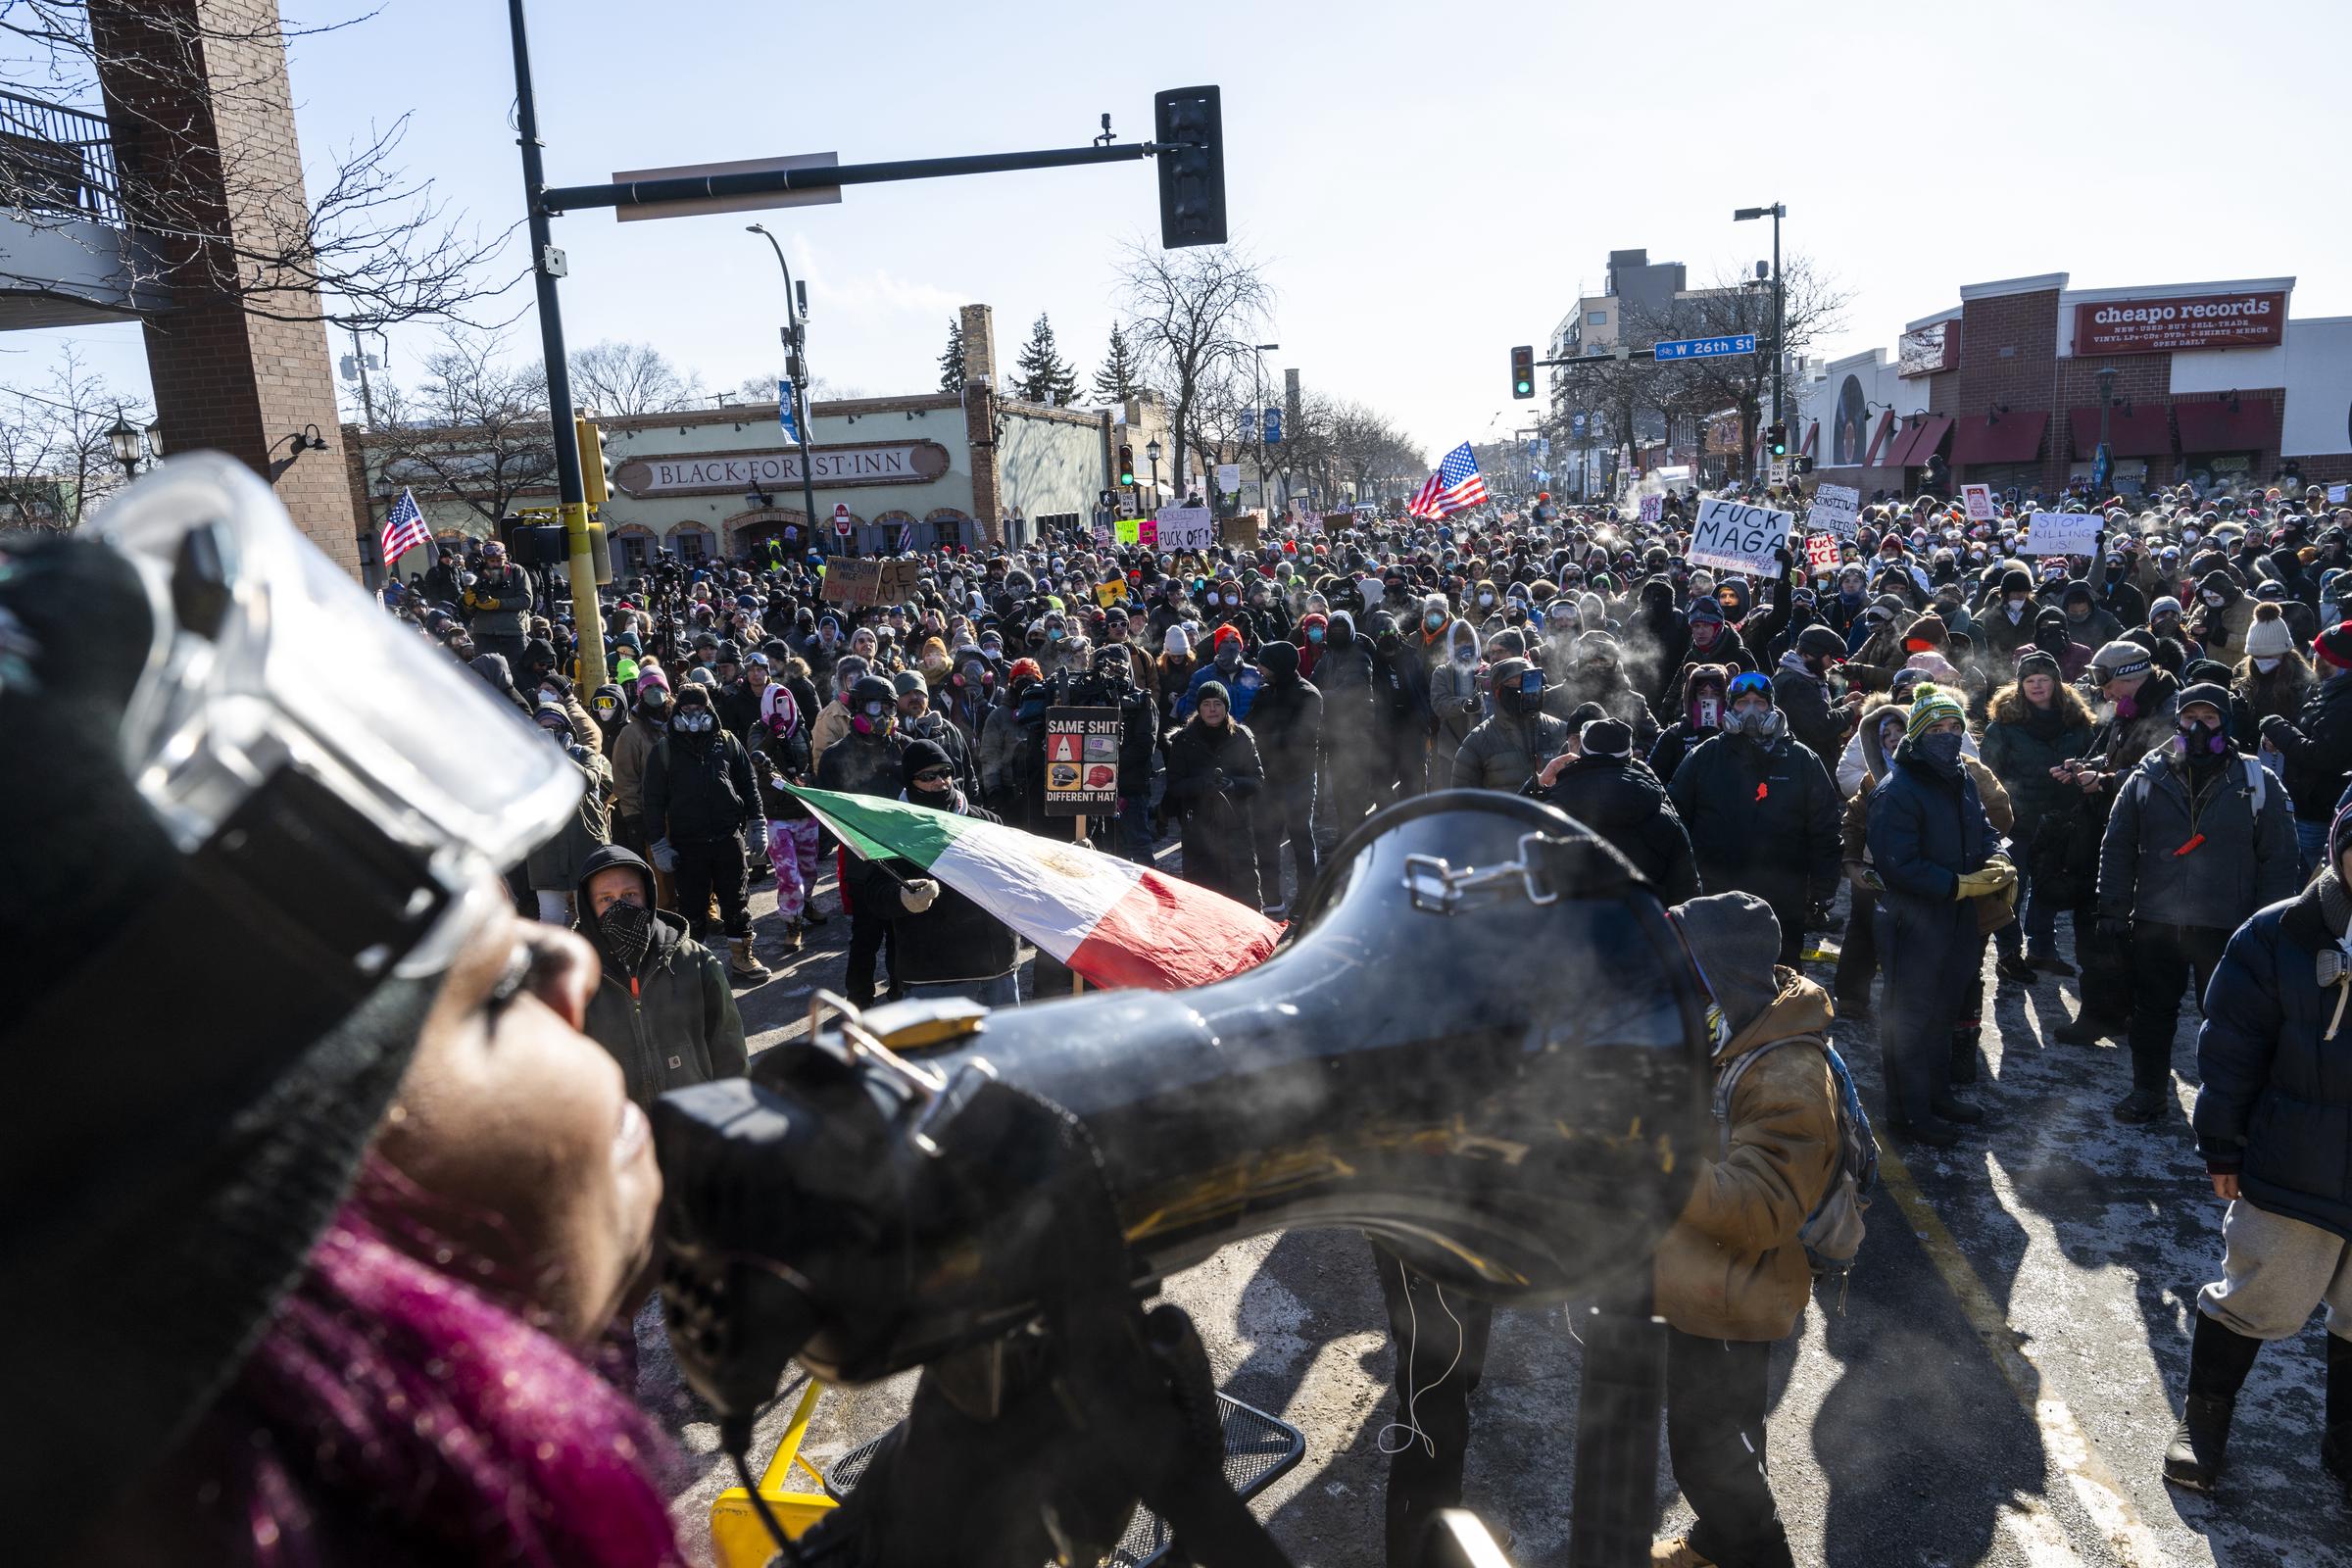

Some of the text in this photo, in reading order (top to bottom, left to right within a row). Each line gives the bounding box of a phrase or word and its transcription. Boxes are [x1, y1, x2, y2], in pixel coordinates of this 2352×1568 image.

[2094, 298, 2271, 324] cheapo records
[2190, 328, 2230, 337] T-SHIRTS
[2236, 326, 2269, 335] MERCH
[1676, 338, 1751, 355] W 26th St
[661, 452, 903, 485] BLACK FORST INN
[1816, 485, 1832, 496] ICE
[1641, 498, 1660, 508] FUCK
[1709, 502, 1783, 530] FUCK
[2038, 514, 2085, 528] STOP
[1159, 530, 1183, 548] FUCK
[1694, 520, 1786, 554] MAGA
[1805, 533, 1838, 550] FUCK
[2034, 529, 2091, 540] KILLING
[1712, 549, 1741, 559] GREAT
[1809, 548, 1840, 565] ICE
[830, 560, 878, 576] MINNESOTA
[1707, 556, 1773, 570] KILLED NAZIS
[839, 571, 858, 581] NICE
[875, 584, 912, 603] UT
[1048, 720, 1118, 734] SAME SHIT
[1047, 791, 1115, 803] DIFFERENT HAT
